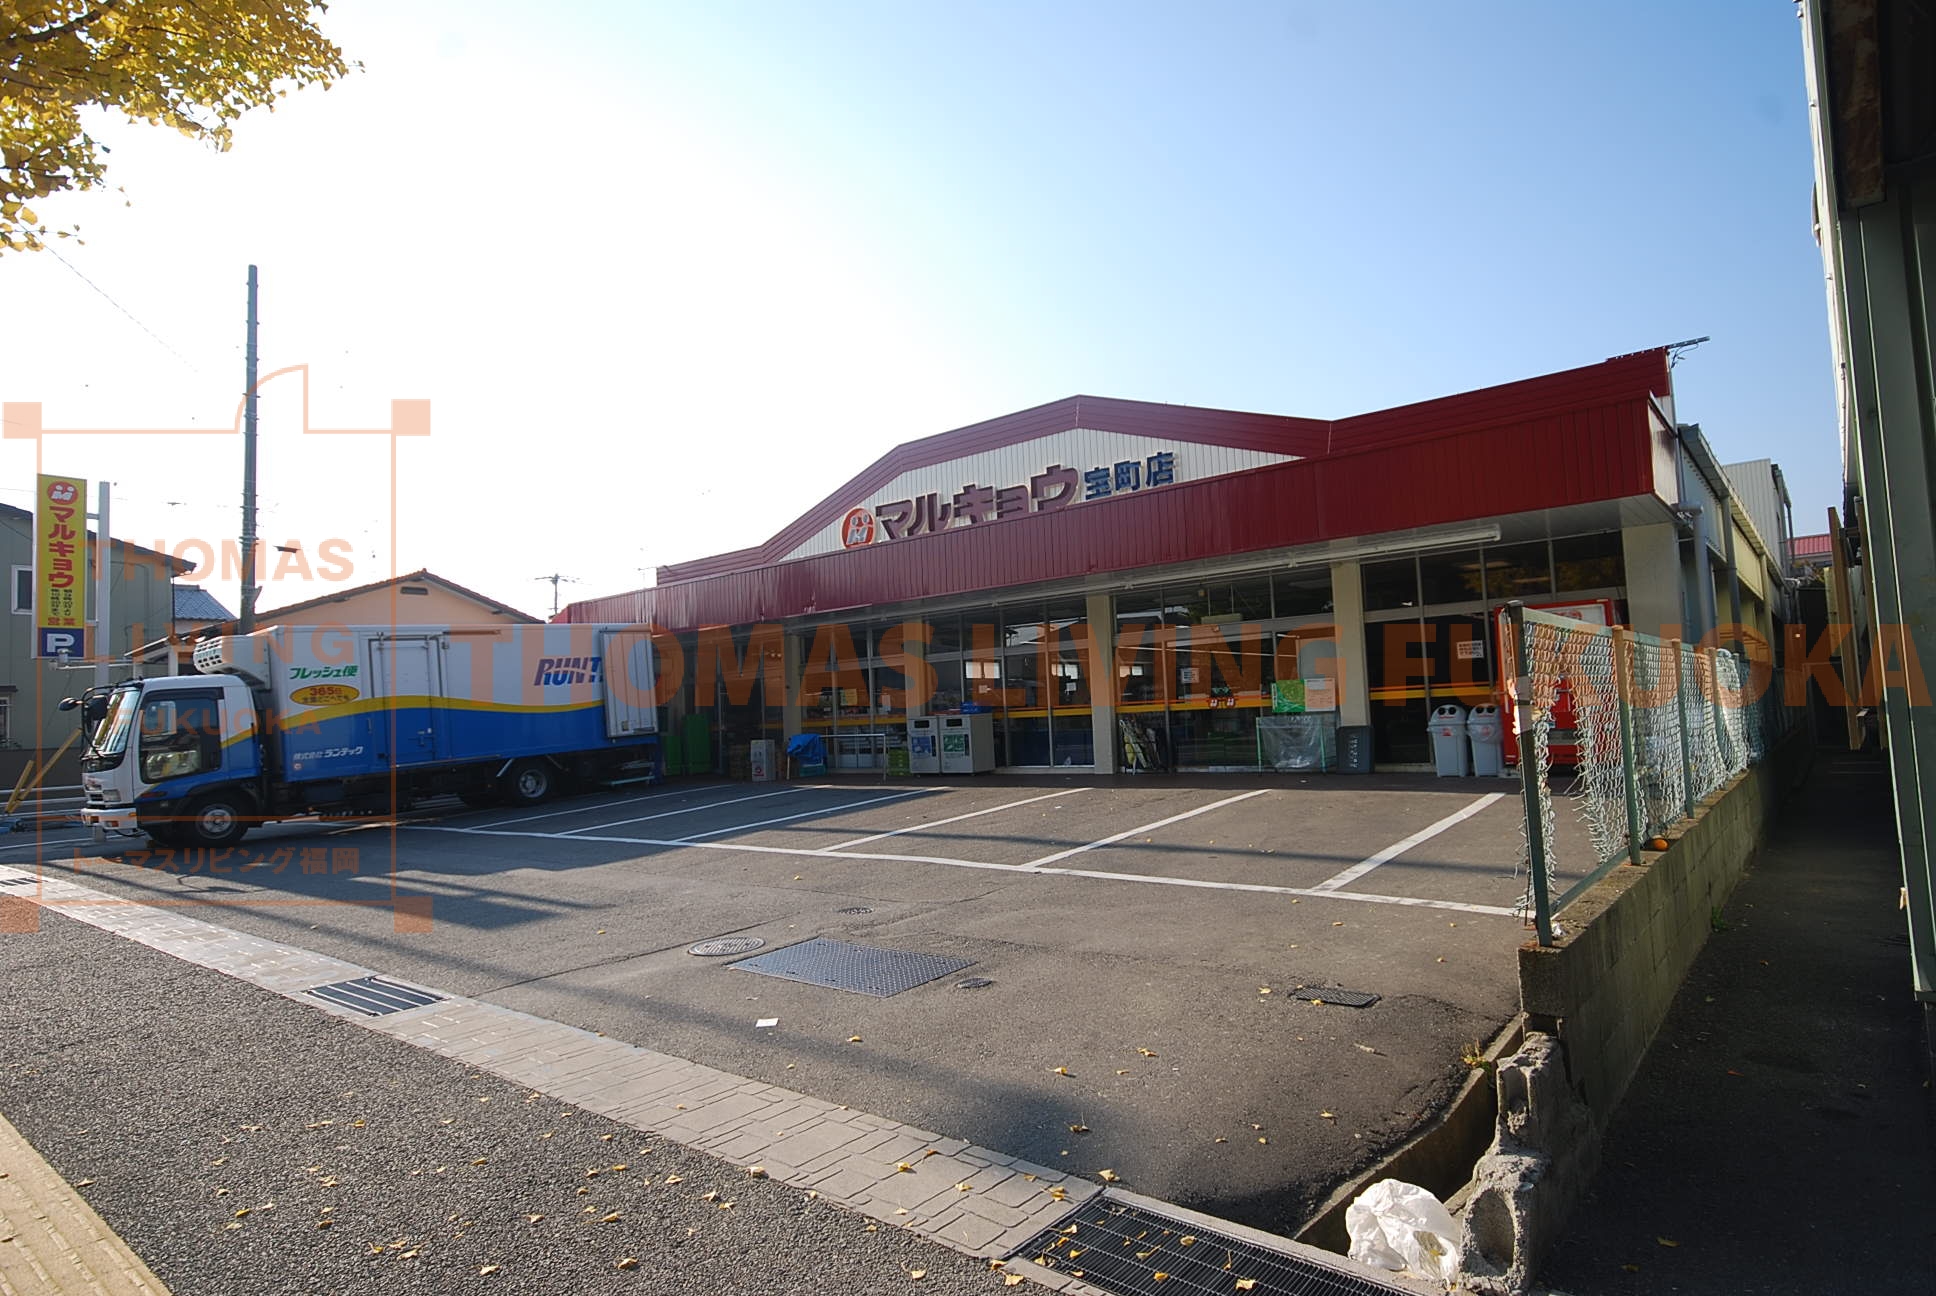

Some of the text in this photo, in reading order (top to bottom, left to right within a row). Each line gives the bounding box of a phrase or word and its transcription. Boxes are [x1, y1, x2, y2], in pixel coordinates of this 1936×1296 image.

[875, 464, 1079, 540] マルキョウ
[1084, 451, 1175, 501] 宝町店
[48, 505, 76, 588] マルキョウ
[46, 633, 75, 653] P
[290, 665, 358, 679] フレッシュ便
